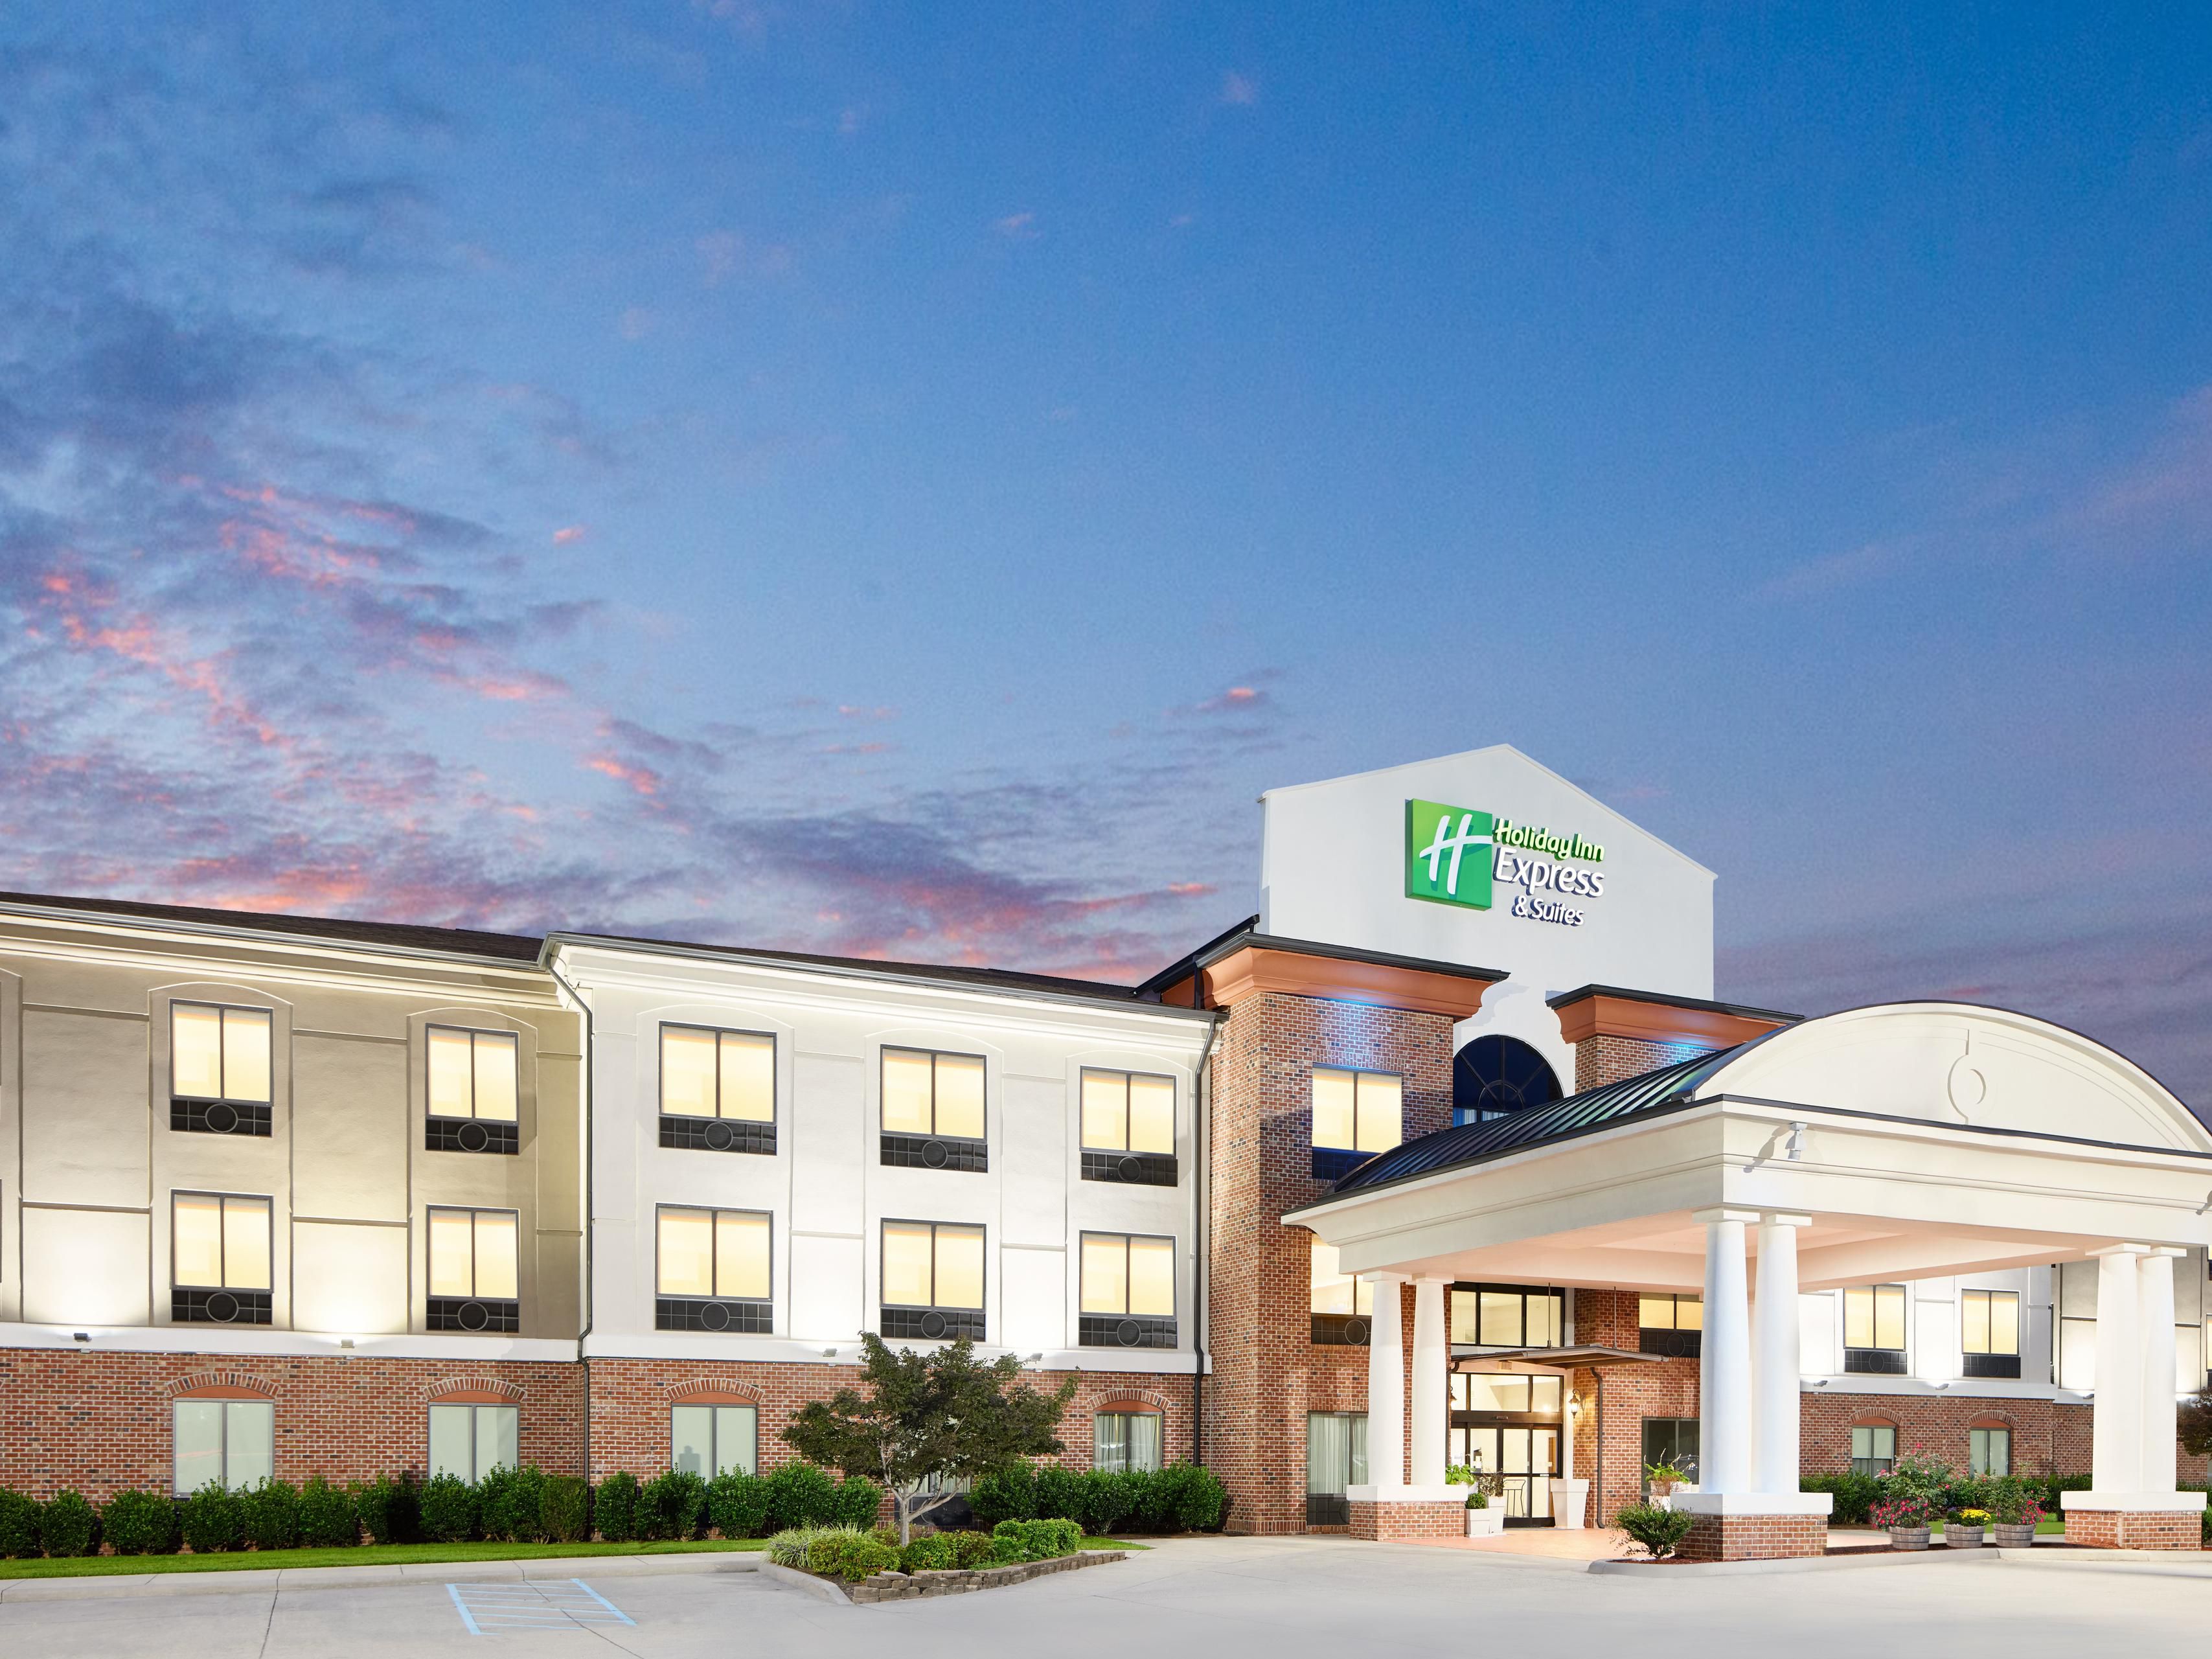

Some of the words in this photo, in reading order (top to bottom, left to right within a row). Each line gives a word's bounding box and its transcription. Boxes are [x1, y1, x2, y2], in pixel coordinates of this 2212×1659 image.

[1492, 818, 1573, 860] Holiday
[1571, 833, 1605, 862] Inn
[1492, 847, 1605, 898] Express
[1512, 895, 1528, 917] &
[1529, 898, 1585, 926] Suites
